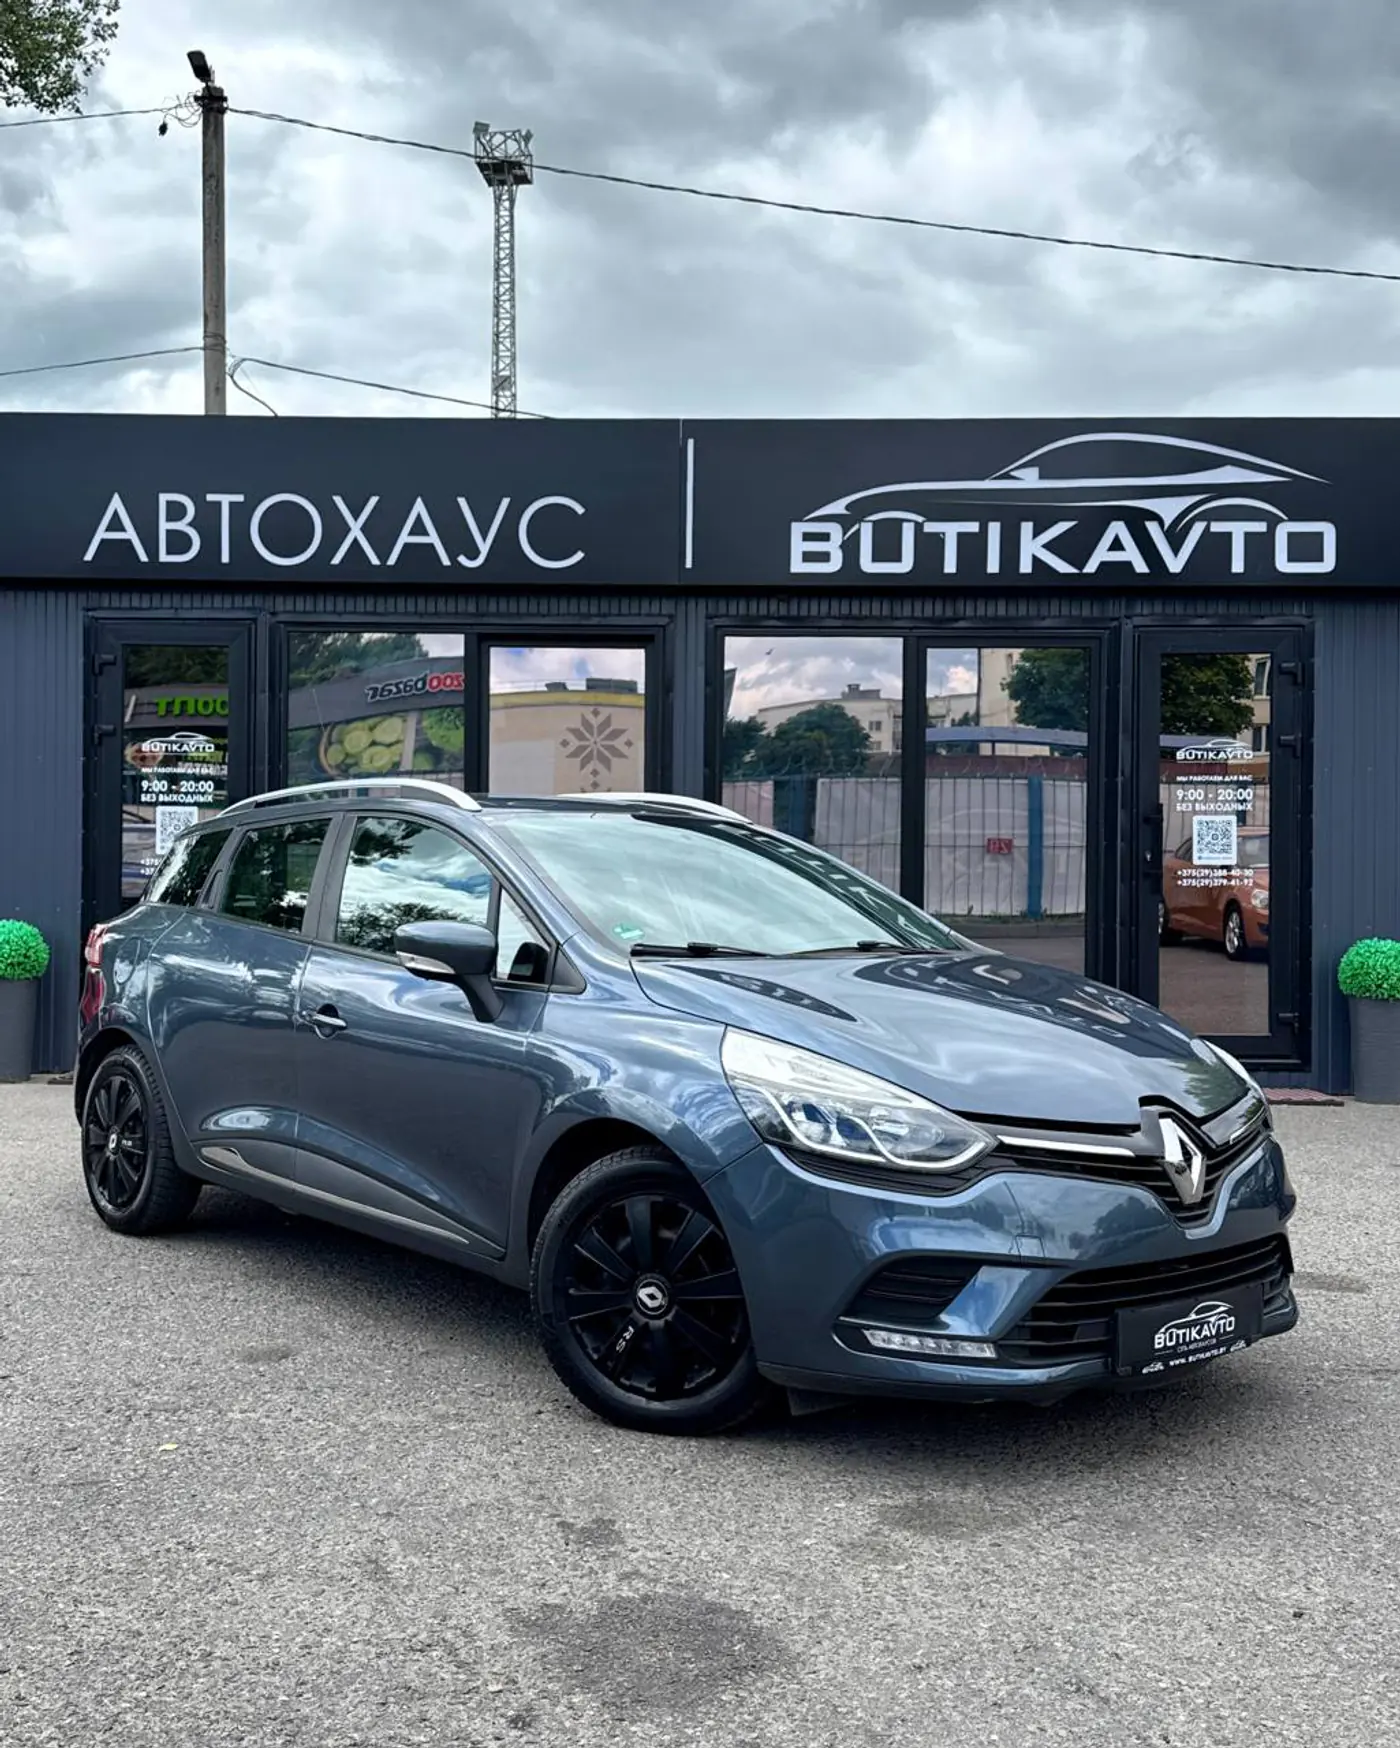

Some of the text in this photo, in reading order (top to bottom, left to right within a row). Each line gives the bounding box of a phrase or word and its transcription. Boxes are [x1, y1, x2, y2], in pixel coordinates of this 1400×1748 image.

[83, 491, 586, 569] АВТОХАУС
[789, 519, 1337, 575] BUTIKAVTO
[141, 742, 215, 752] BUTIKAVTO
[1176, 750, 1253, 760] BUTIKAVTO
[141, 780, 168, 792] 9:00
[180, 780, 214, 792] 20:00
[141, 793, 213, 803] БЕЗ ВЫХОДНЫХ
[1176, 789, 1204, 801] 9:00
[1217, 788, 1253, 801] 20:00
[1176, 802, 1253, 812] БЕЗ ВЫХОДНЫХ
[1154, 1316, 1236, 1348] BUTIKAVTO
